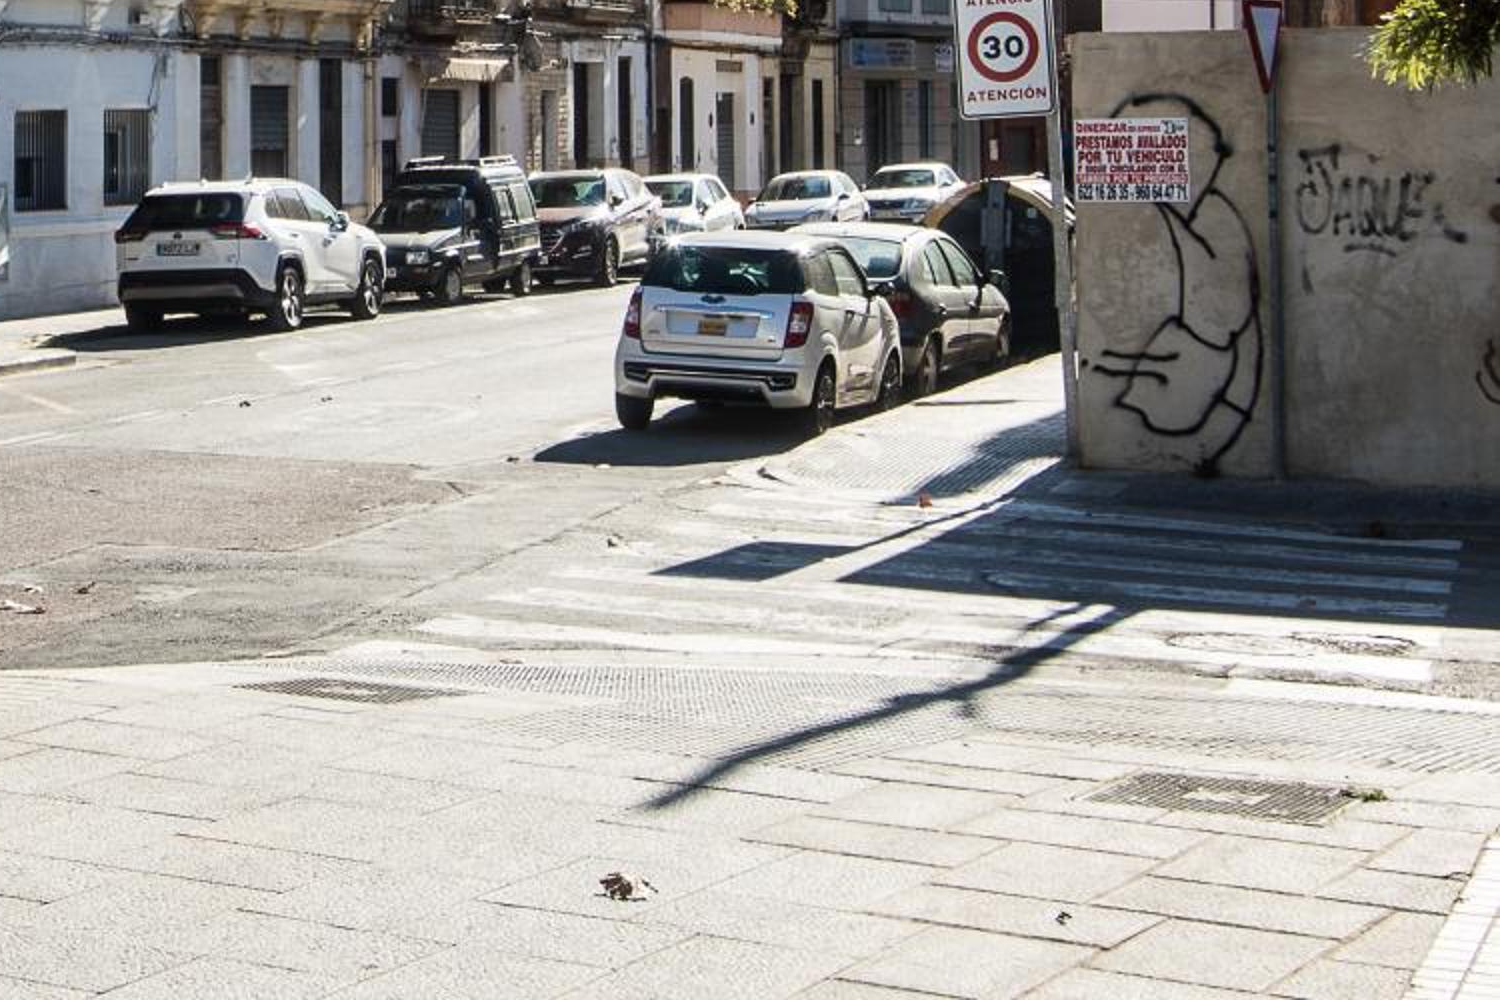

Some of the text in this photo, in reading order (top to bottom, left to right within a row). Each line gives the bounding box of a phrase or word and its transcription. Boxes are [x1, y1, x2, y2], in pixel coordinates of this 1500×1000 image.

[983, 35, 1024, 59] 30
[967, 84, 1047, 102] ATENCIÓN
[1076, 122, 1127, 133] DINERCAR
[1075, 134, 1187, 150] PRESTAMOS AVALADOS
[1078, 150, 1185, 163] POR TU VEHICULO
[1109, 164, 1157, 173] CIRCULANDO
[1160, 165, 1175, 173] CON
[1077, 184, 1094, 200] 622
[1095, 184, 1105, 200] 16
[1118, 184, 1129, 200] 35
[1152, 184, 1164, 200] 64
[1164, 184, 1176, 199] 47
